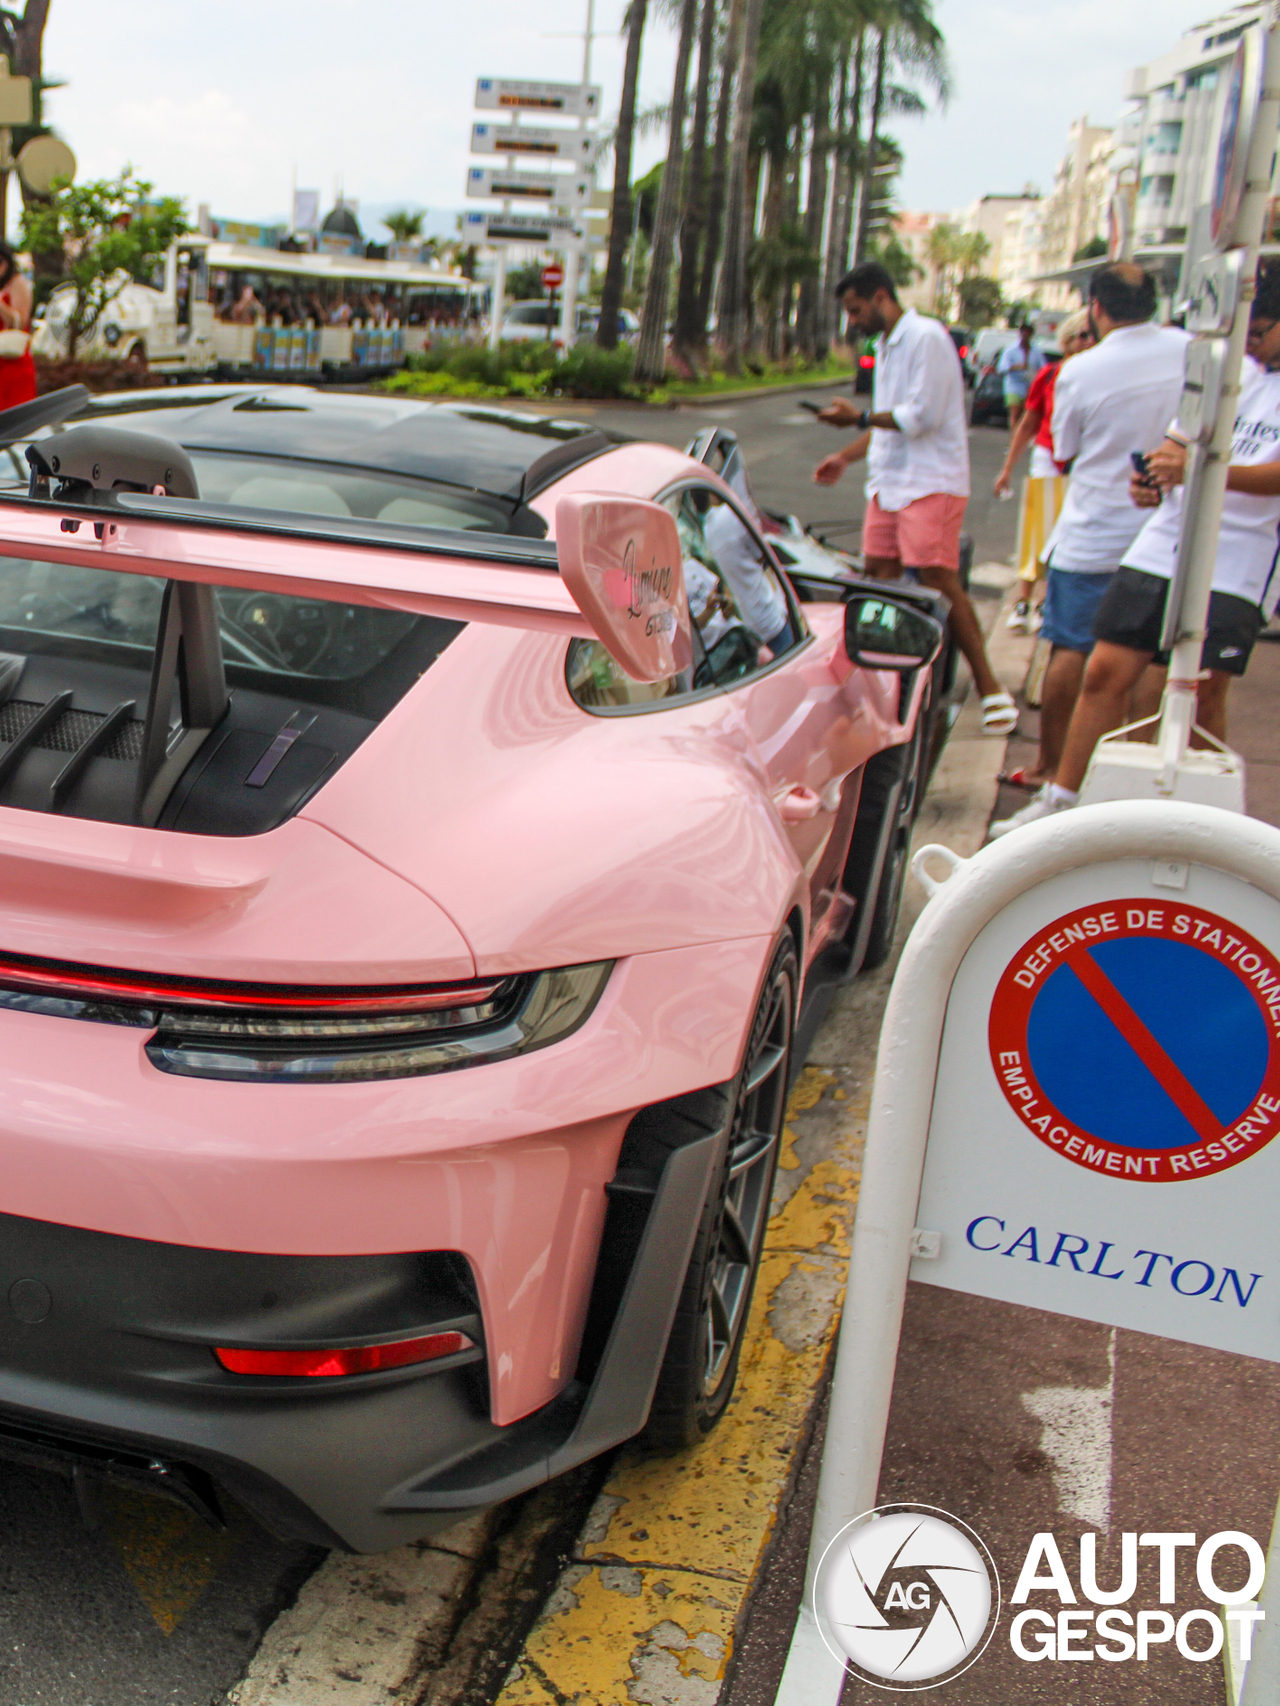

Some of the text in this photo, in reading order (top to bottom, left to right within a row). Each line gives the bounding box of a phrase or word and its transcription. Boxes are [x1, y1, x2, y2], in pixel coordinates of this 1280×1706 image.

[1232, 416, 1279, 442] irates
[1013, 909, 1280, 1038] DEFENSE DE STATIONNE
[999, 1051, 1280, 1175] EMPLACEMENT RESERVE
[965, 1215, 1265, 1308] CARLTON
